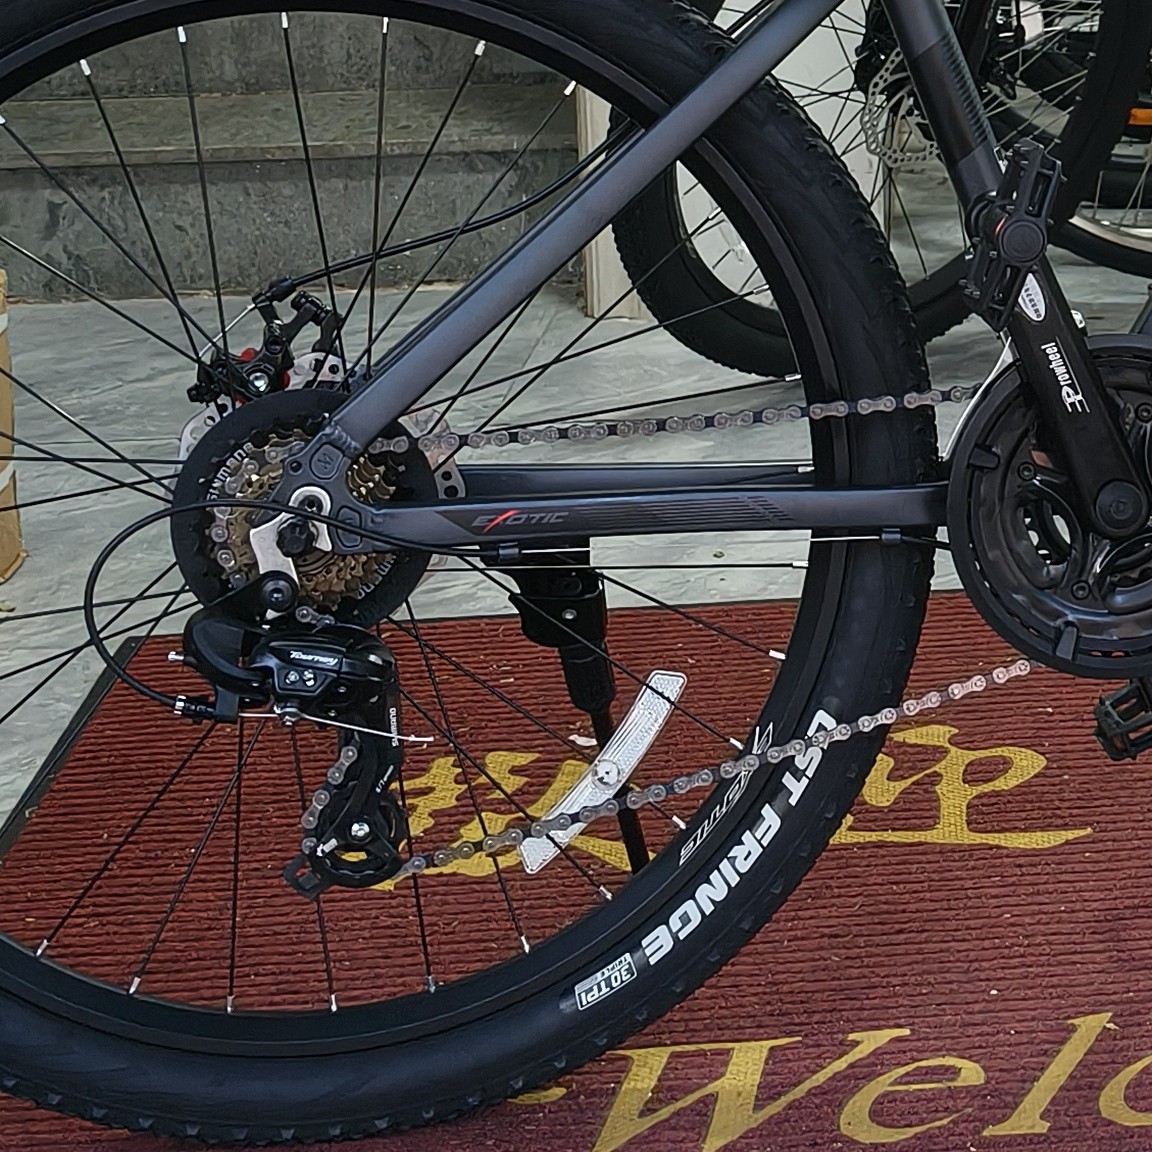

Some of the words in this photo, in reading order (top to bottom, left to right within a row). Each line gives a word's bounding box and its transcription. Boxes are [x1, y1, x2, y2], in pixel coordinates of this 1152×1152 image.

[1041, 341, 1090, 413] Prowheel
[471, 509, 569, 532] EXOTIC
[679, 722, 773, 866] EOTIC
[641, 803, 782, 965] FRINGE
[580, 980, 611, 1006] TPI
[611, 964, 631, 988] 30
